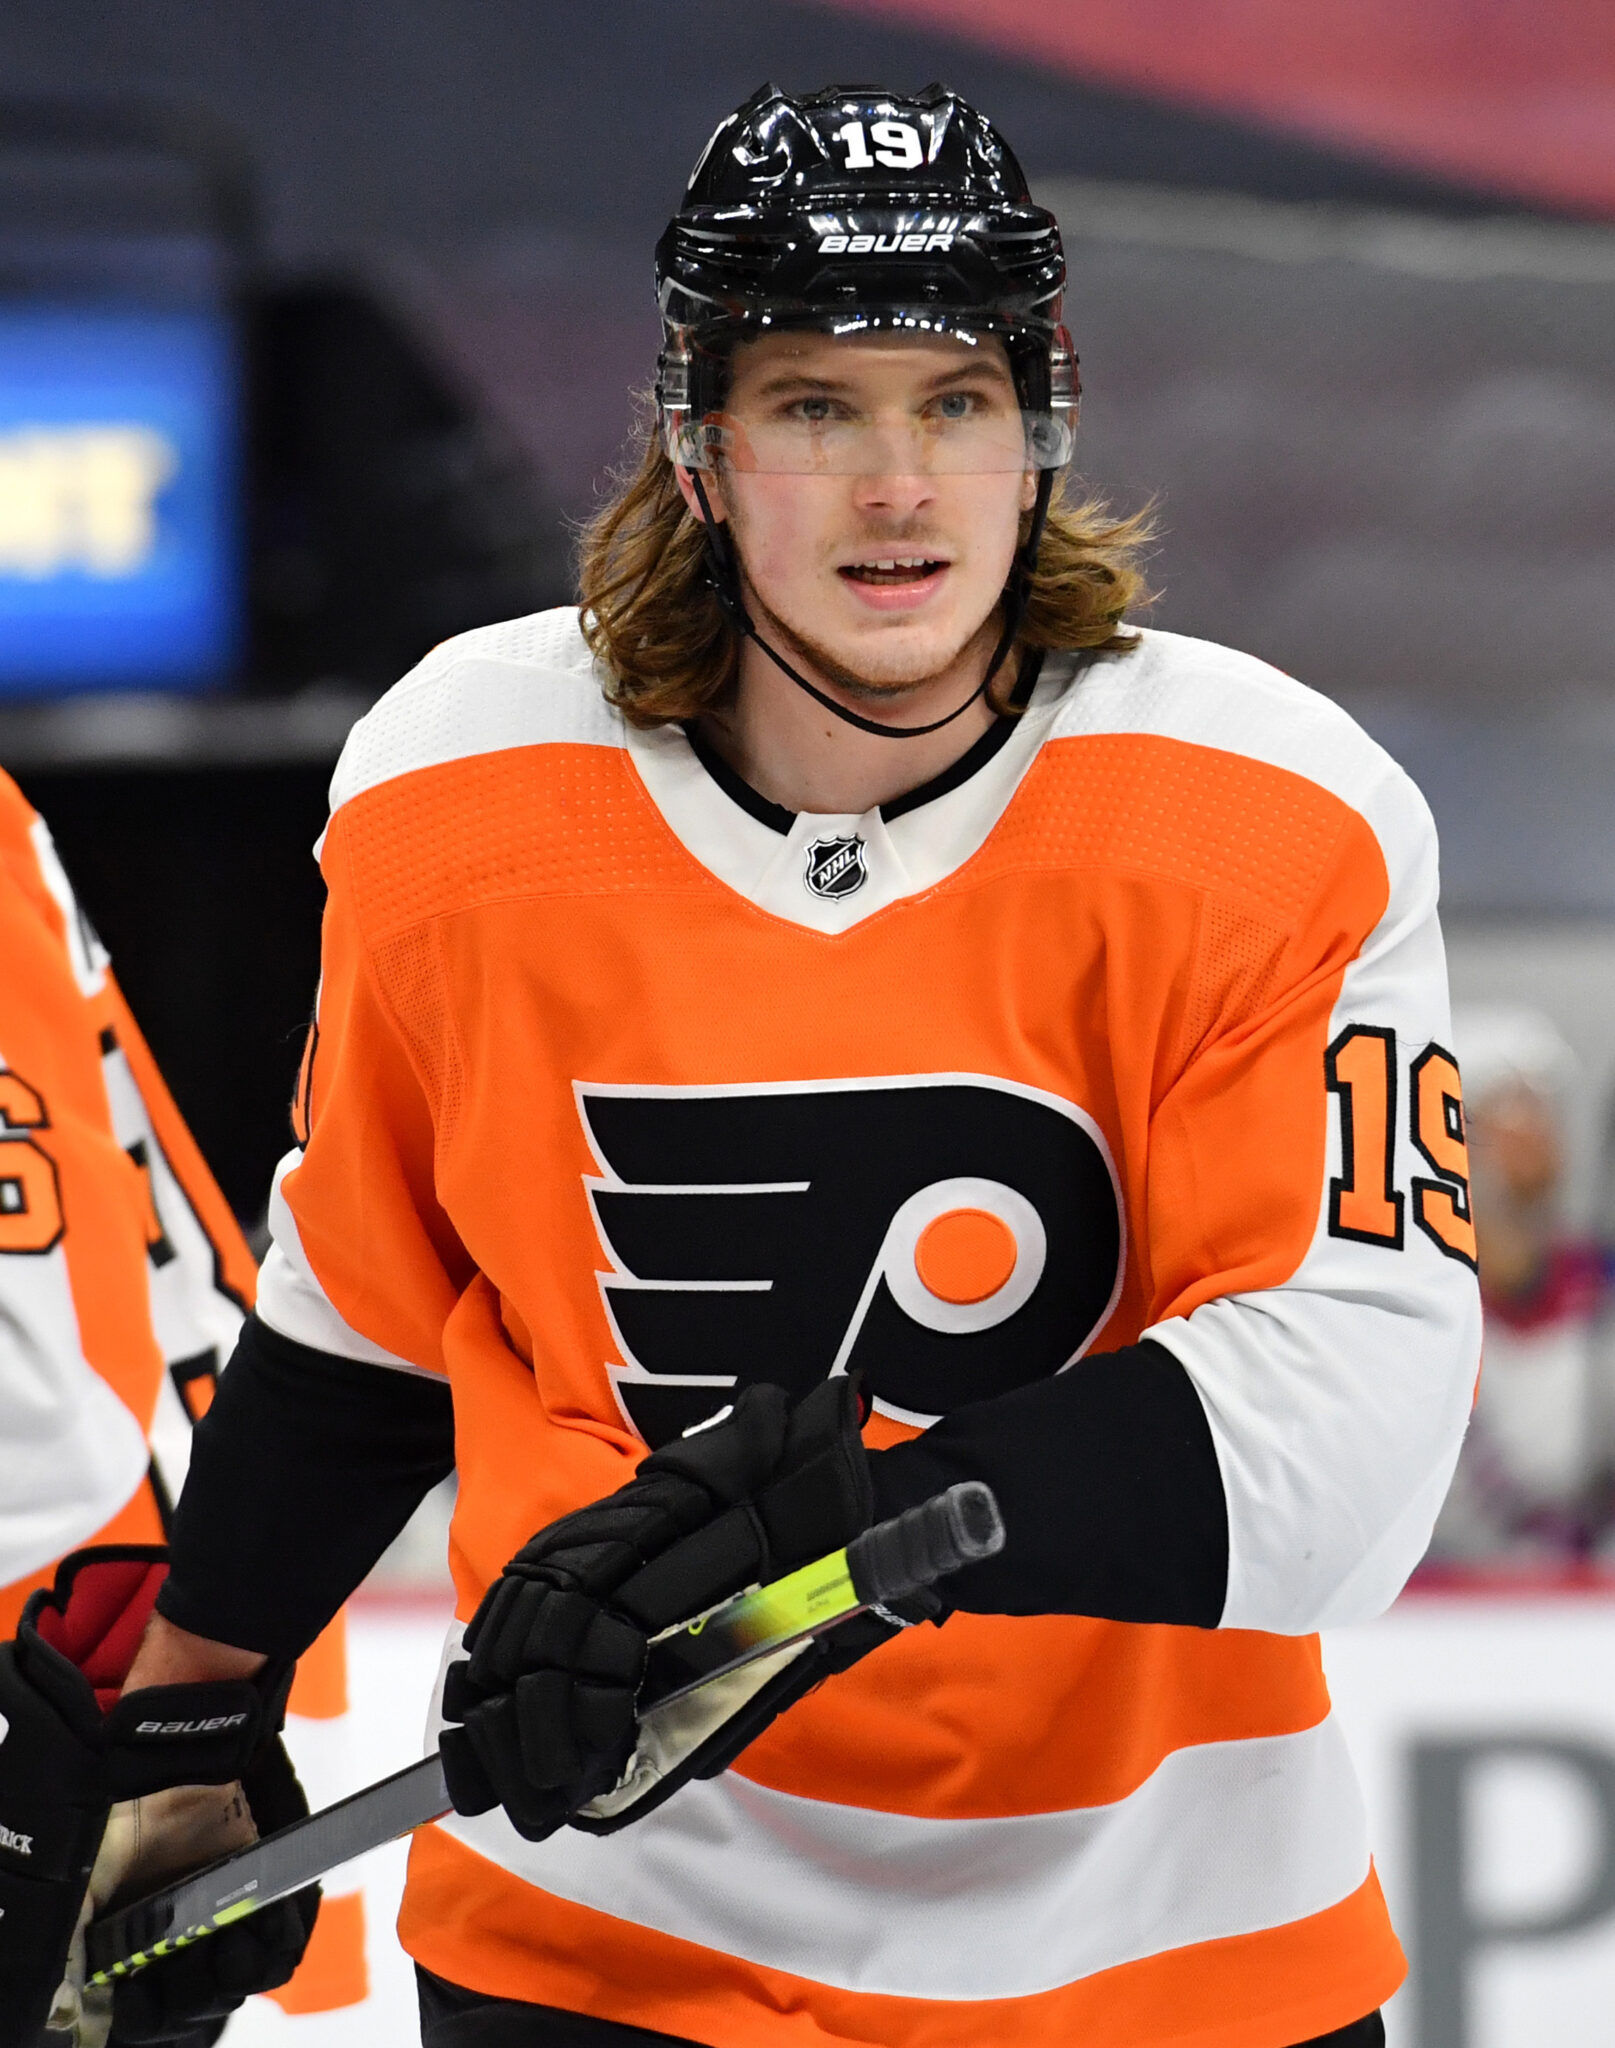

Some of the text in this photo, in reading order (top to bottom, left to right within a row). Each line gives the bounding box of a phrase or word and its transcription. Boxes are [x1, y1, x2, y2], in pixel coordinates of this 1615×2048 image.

[840, 121, 924, 169] 19
[818, 234, 951, 253] BAUER
[818, 849, 856, 887] NHL
[1324, 1024, 1479, 1276] 19
[136, 1713, 247, 1733] BAUER
